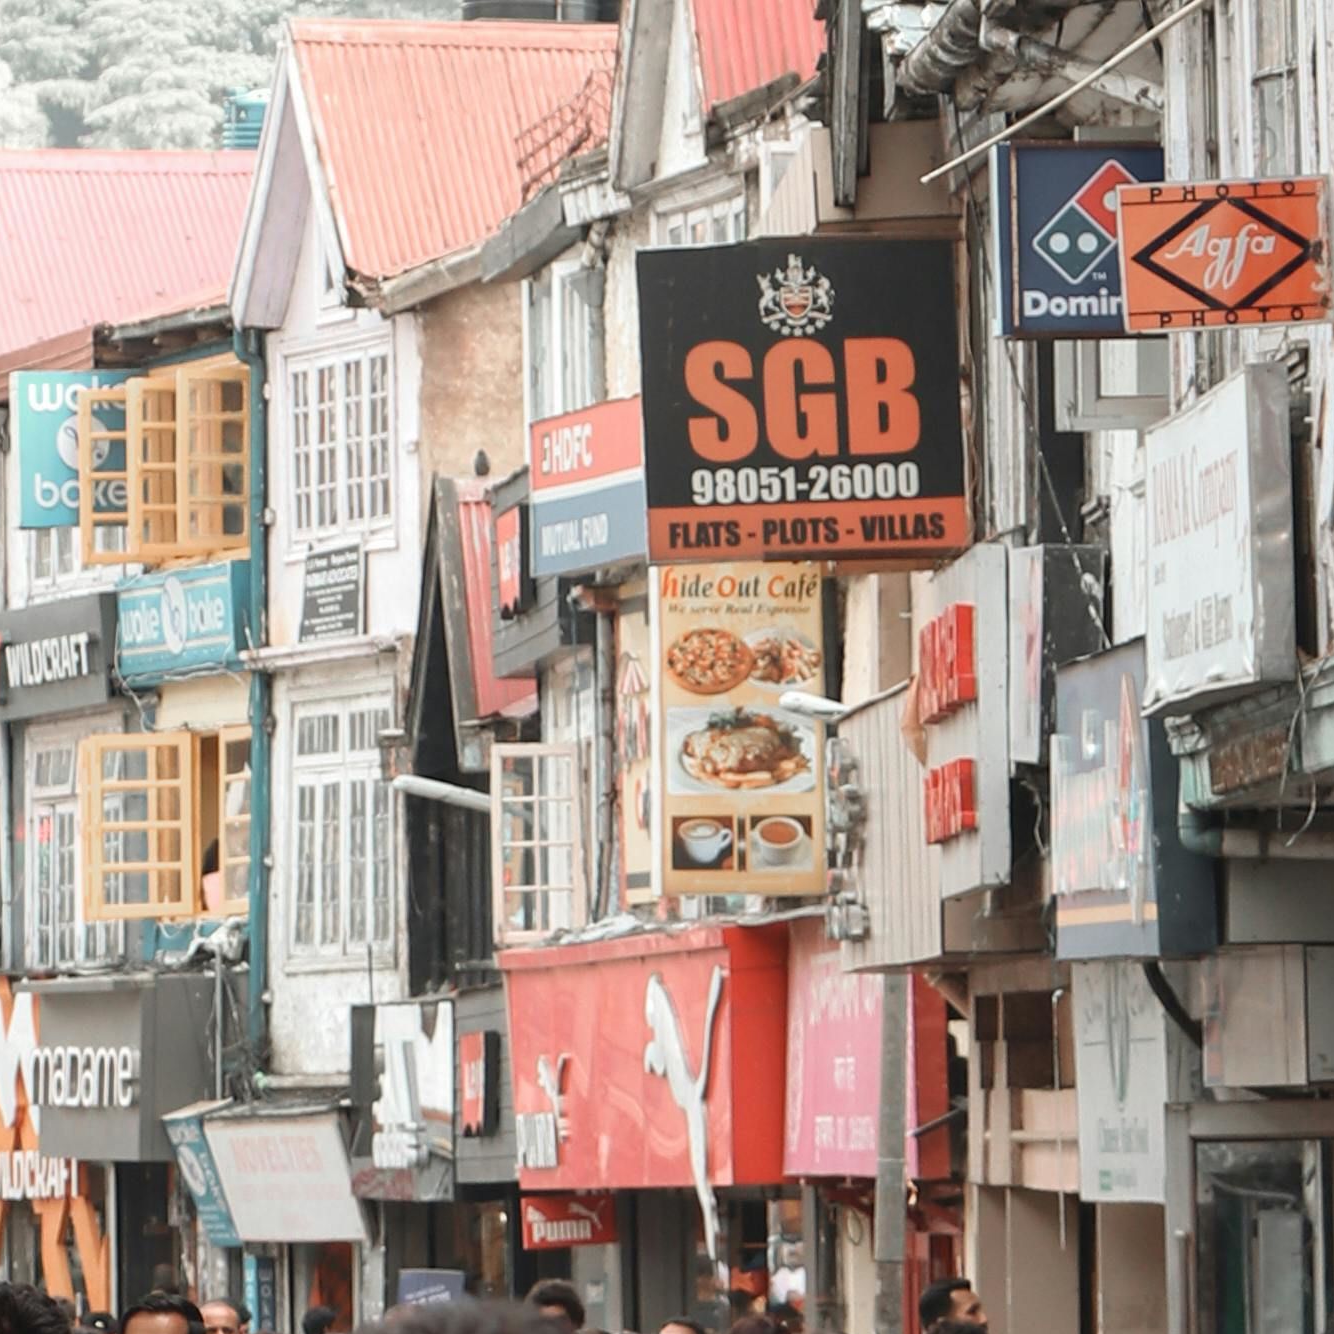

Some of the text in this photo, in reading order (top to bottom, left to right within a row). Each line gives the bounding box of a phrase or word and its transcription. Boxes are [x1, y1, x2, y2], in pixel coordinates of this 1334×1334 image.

[1150, 181, 1296, 203] PHOTO
[1165, 223, 1276, 290] Agfa
[1159, 306, 1305, 329] PHOTO
[684, 337, 922, 463] SGB
[550, 422, 594, 475] HDFC
[691, 461, 920, 506] 98051-26000
[540, 512, 609, 557] MUTUAL FUND
[669, 520, 741, 549] FLATS
[762, 517, 839, 545] PLOTS
[862, 513, 945, 541] VILLAS
[717, 575, 761, 598] Out
[767, 572, 818, 601] Café
[5, 631, 89, 688] WILDCRAFT
